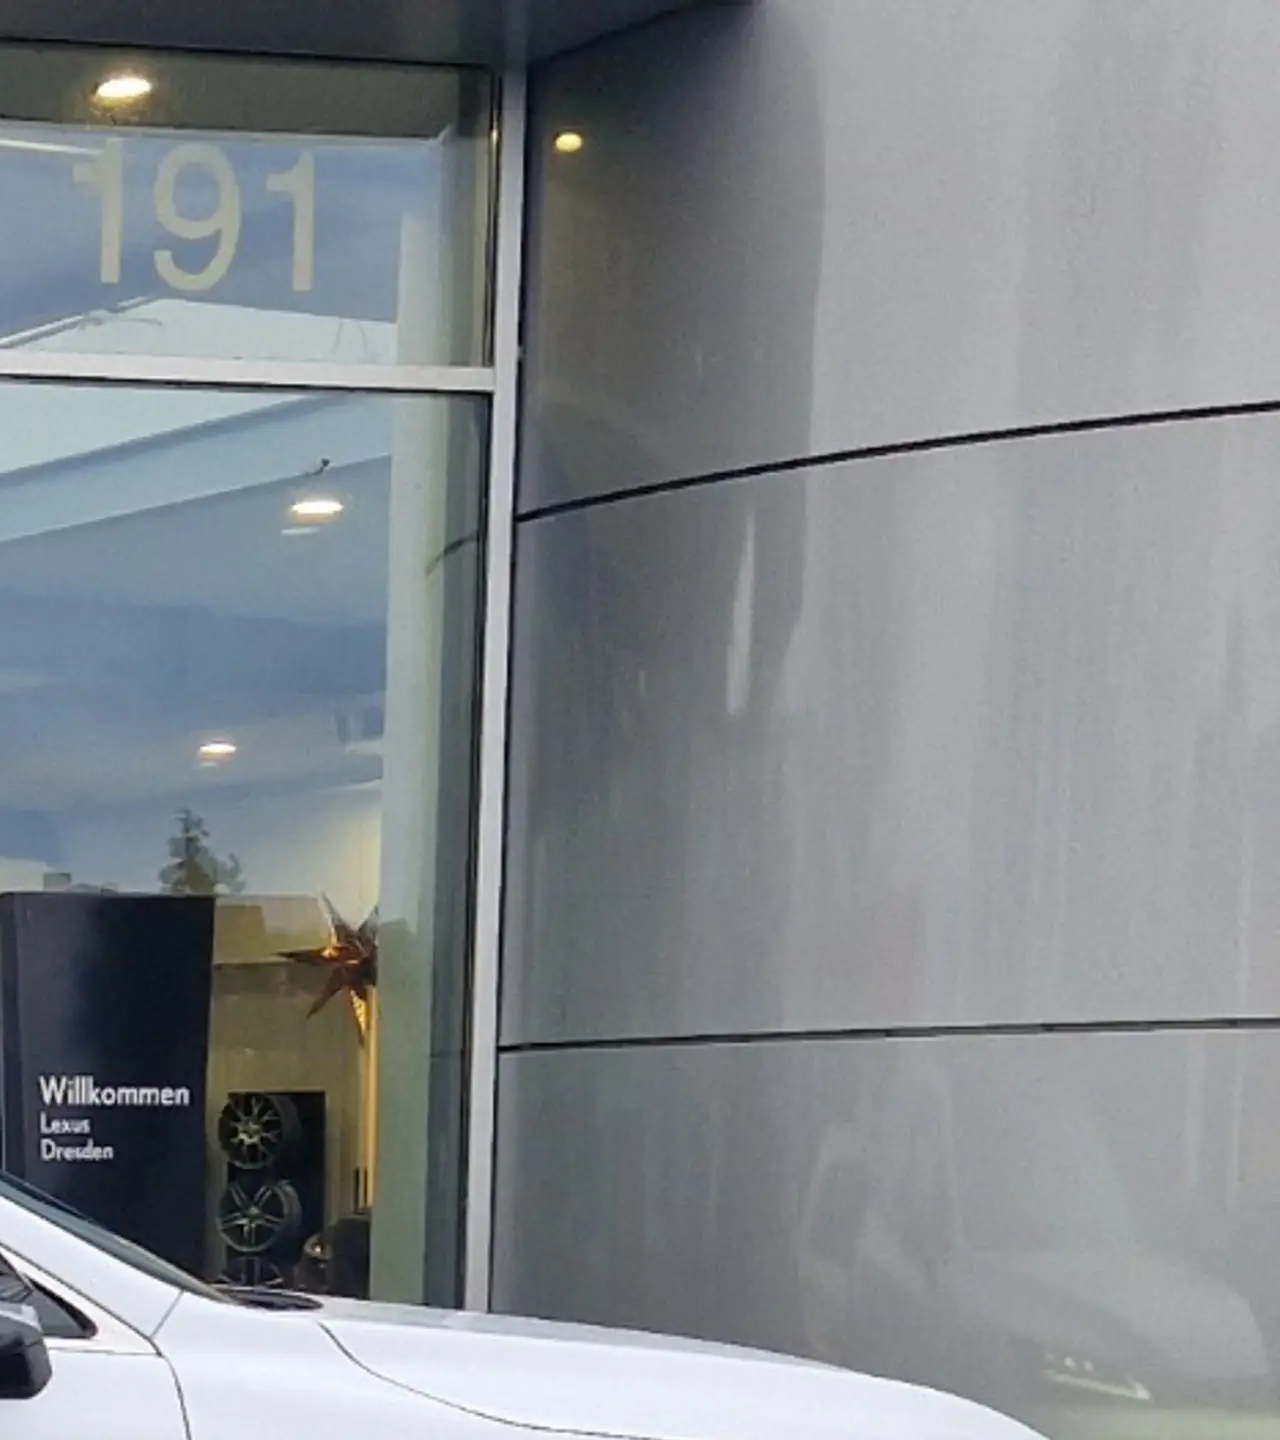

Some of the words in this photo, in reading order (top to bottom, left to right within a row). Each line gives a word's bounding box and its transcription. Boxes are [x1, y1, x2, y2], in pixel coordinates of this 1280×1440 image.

[73, 136, 317, 292] 191
[39, 1075, 190, 1106] Willkommen
[40, 1111, 90, 1134] Lexus
[40, 1137, 114, 1161] Dresden
